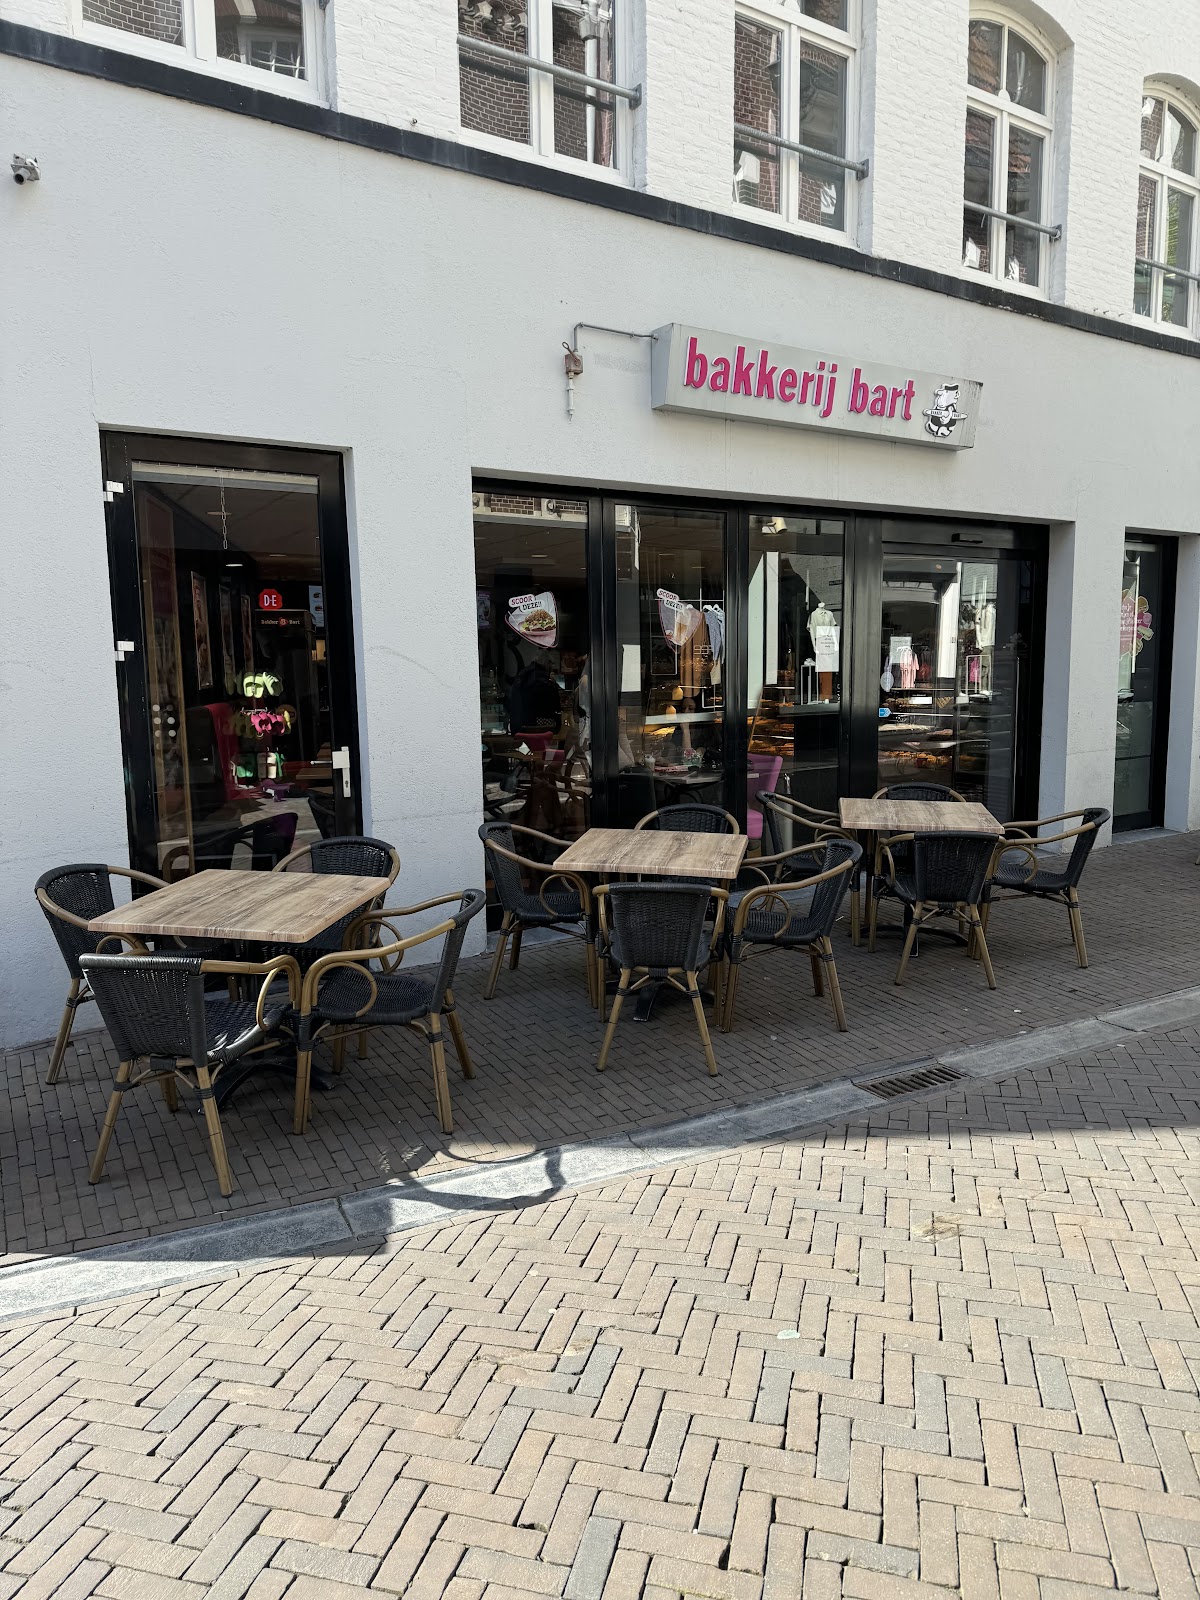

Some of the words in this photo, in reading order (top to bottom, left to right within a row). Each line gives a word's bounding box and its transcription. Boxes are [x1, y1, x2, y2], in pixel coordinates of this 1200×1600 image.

[684, 336, 837, 417] bakkerij
[848, 367, 915, 420] bart
[510, 595, 533, 606] SCOOR
